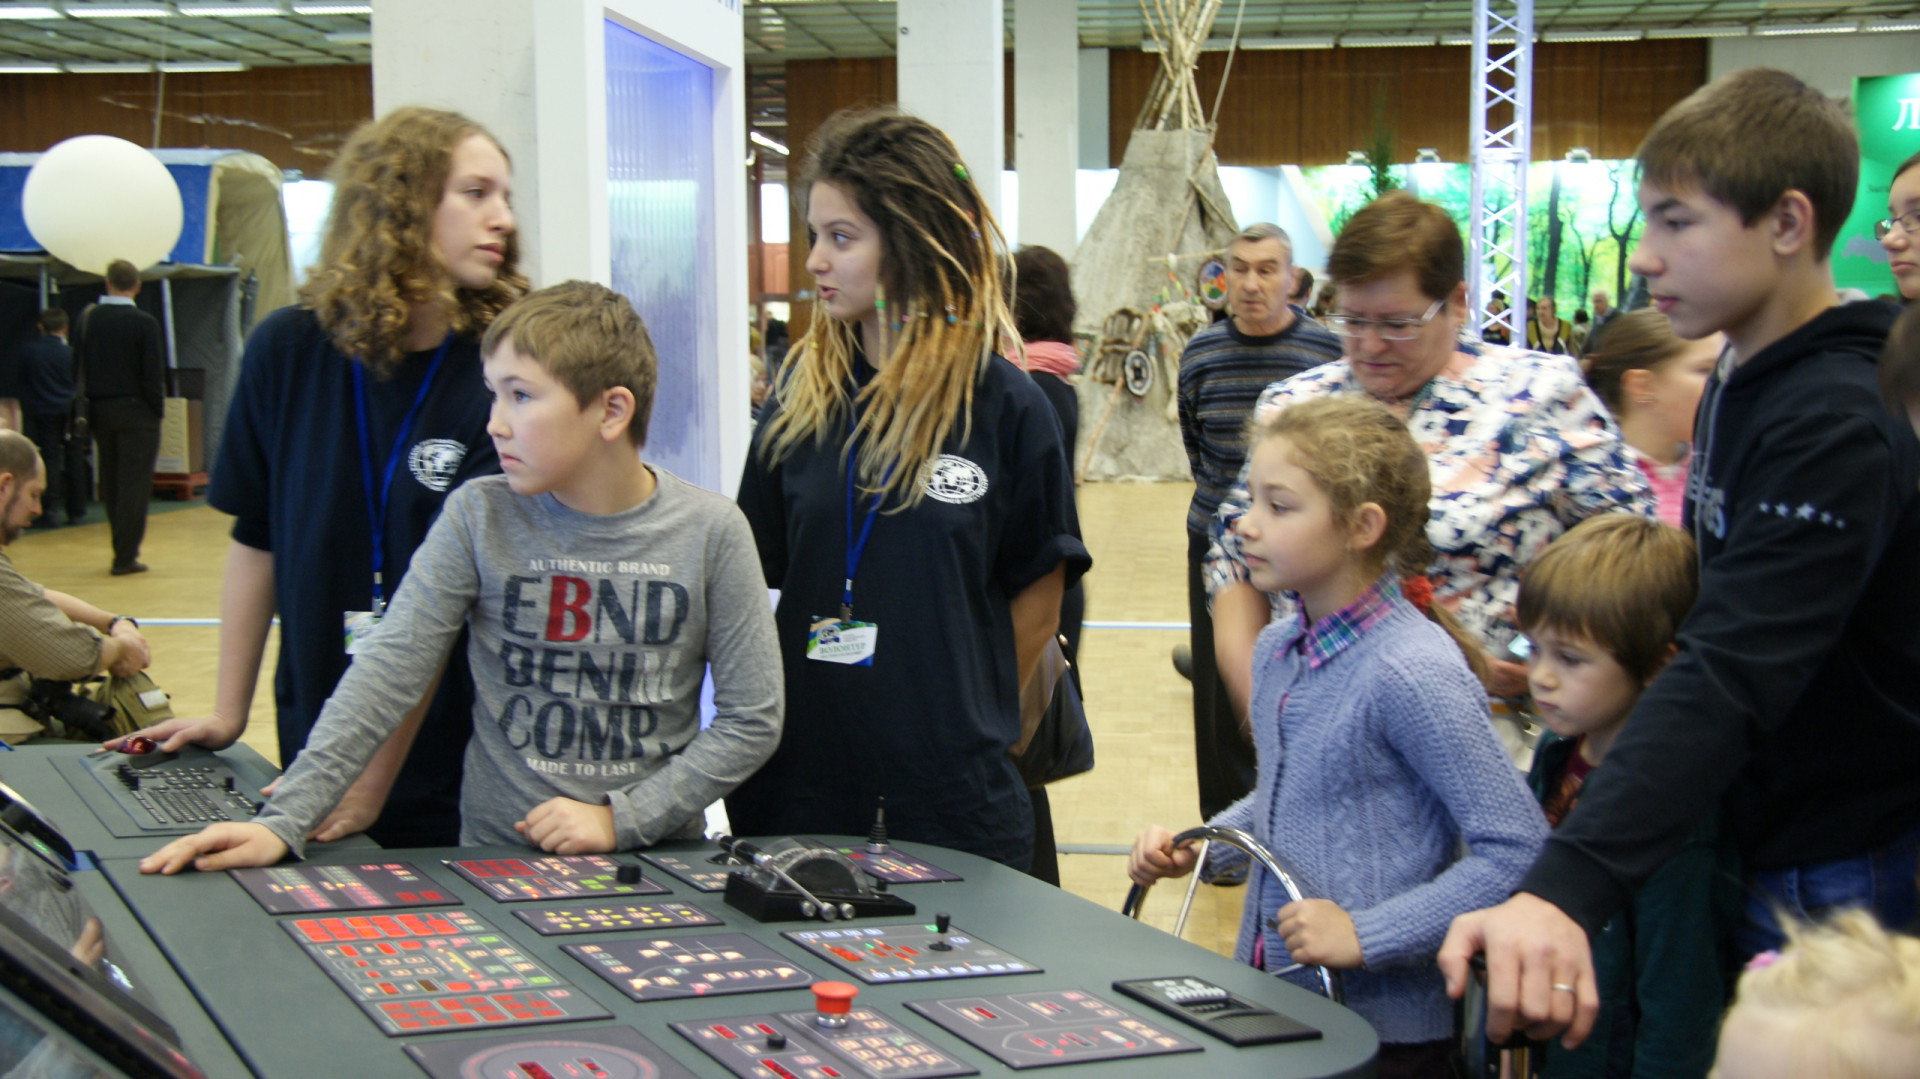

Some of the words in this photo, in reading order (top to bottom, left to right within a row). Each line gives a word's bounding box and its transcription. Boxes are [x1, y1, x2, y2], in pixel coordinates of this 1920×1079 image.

[529, 559, 614, 574] AUTHENTIC
[618, 561, 670, 576] BRAND
[503, 575, 690, 645] EBND
[526, 757, 569, 775] MADE
[574, 763, 596, 776] TO
[601, 761, 636, 776] LAST
